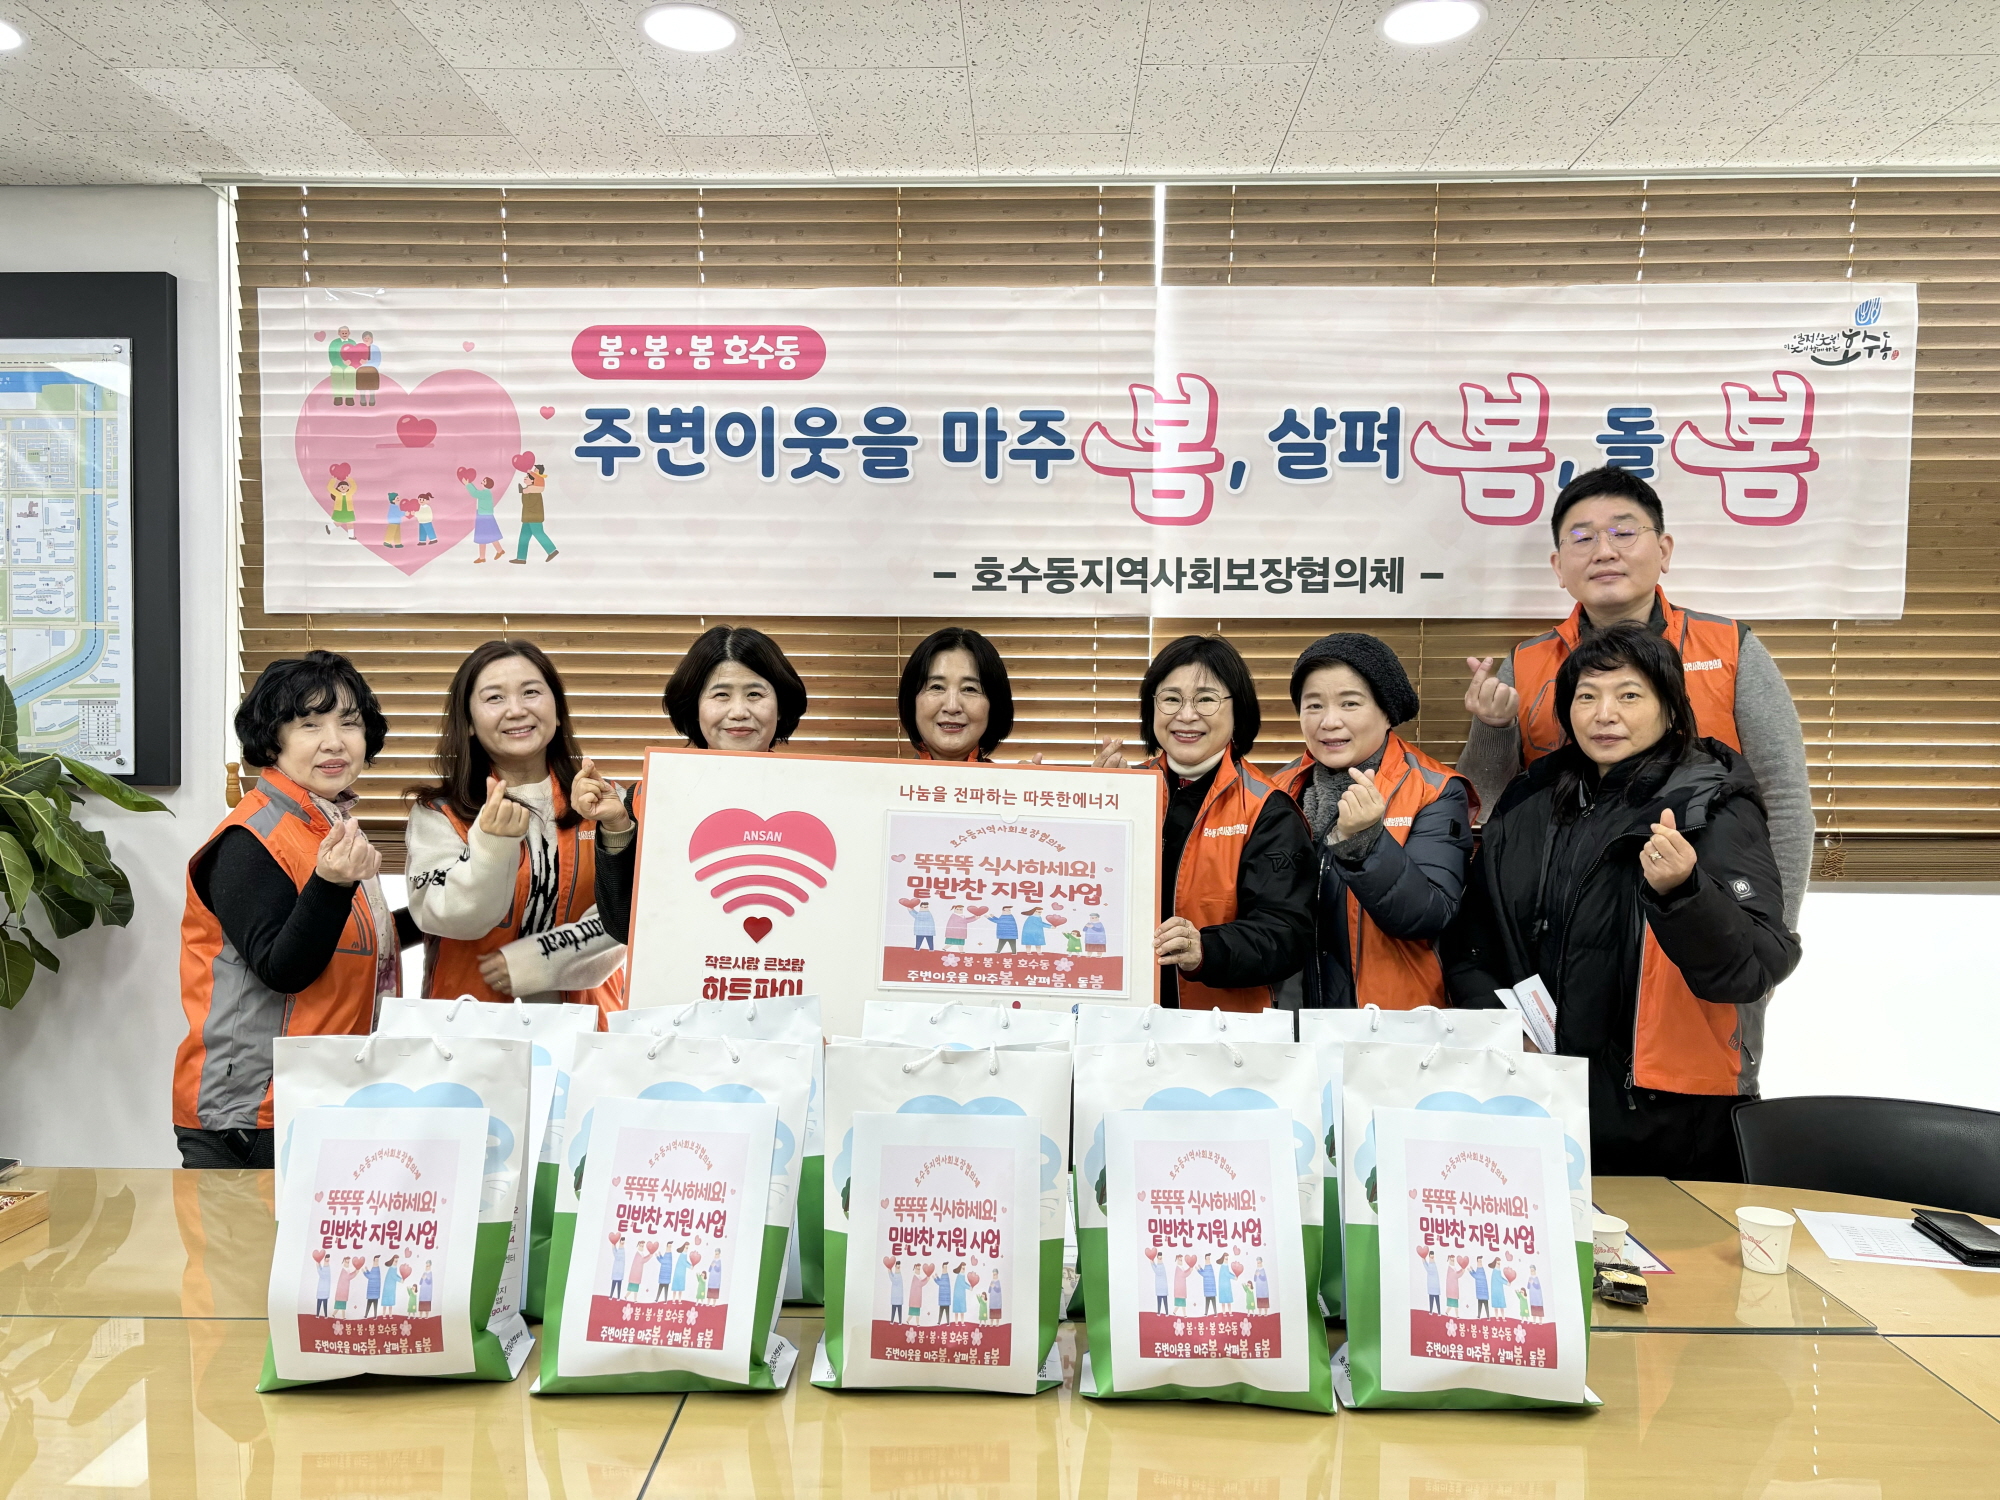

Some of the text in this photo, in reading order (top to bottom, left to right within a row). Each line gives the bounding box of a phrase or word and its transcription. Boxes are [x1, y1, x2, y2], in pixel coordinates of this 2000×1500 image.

[722, 335, 800, 370] 호수동
[1810, 328, 1892, 366] 호수동
[574, 405, 919, 480] 주변이웃을
[1595, 370, 1820, 526] 돌봄
[971, 556, 1405, 595] 호수동지역사회보장협의체
[899, 784, 1120, 810] 나눔을 전파하는 따뜻한에너지
[743, 830, 783, 843] ANSAN
[949, 824, 1067, 853] 호수동지역사회보장협의체
[913, 852, 1096, 879] 똑똑똑 식사하세요!
[906, 876, 1104, 906] 밑반찬 지원 사업
[704, 955, 806, 973] 작은사랑 큰보람
[1017, 958, 1050, 971] 호수동
[702, 976, 803, 1001] 하트파이
[907, 969, 969, 984] 주변이웃을
[1077, 974, 1105, 989] 돌봄
[623, 1175, 727, 1204] 똑똑똑 식사하세요!
[1150, 1189, 1256, 1215] 똑똑똑 식사하세요!
[327, 1190, 437, 1216] 똑똑똑 식사하세요!
[893, 1196, 997, 1223] 똑똑똑 식사하세요!
[1422, 1187, 1529, 1219] 똑똑똑 식사하세요!
[616, 1203, 727, 1239] 밑반찬 지원 사업
[1147, 1218, 1262, 1248] 밑반찬 지원 사업
[320, 1219, 438, 1250] 밑반찬 지원 사업
[888, 1226, 1001, 1258] 밑반찬 지원 사업
[1419, 1216, 1536, 1255] 밑반찬 지원 사업
[664, 1309, 684, 1323] 호수동
[1218, 1321, 1238, 1336] 호수동
[377, 1323, 398, 1336] 호수동
[600, 1325, 636, 1344] 주변이웃을
[696, 1328, 714, 1349] 돌봄
[949, 1331, 969, 1346] 호수동
[1491, 1325, 1512, 1342] 호수동
[314, 1339, 350, 1354] 주변이웃을
[415, 1337, 432, 1353] 돌봄
[885, 1347, 921, 1362] 주변이웃을
[983, 1347, 1000, 1365] 돌봄
[1154, 1342, 1191, 1358] 주변이웃을
[1254, 1338, 1270, 1358] 돌봄
[1425, 1341, 1464, 1360] 주변이웃을
[1529, 1347, 1546, 1368] 돌봄
